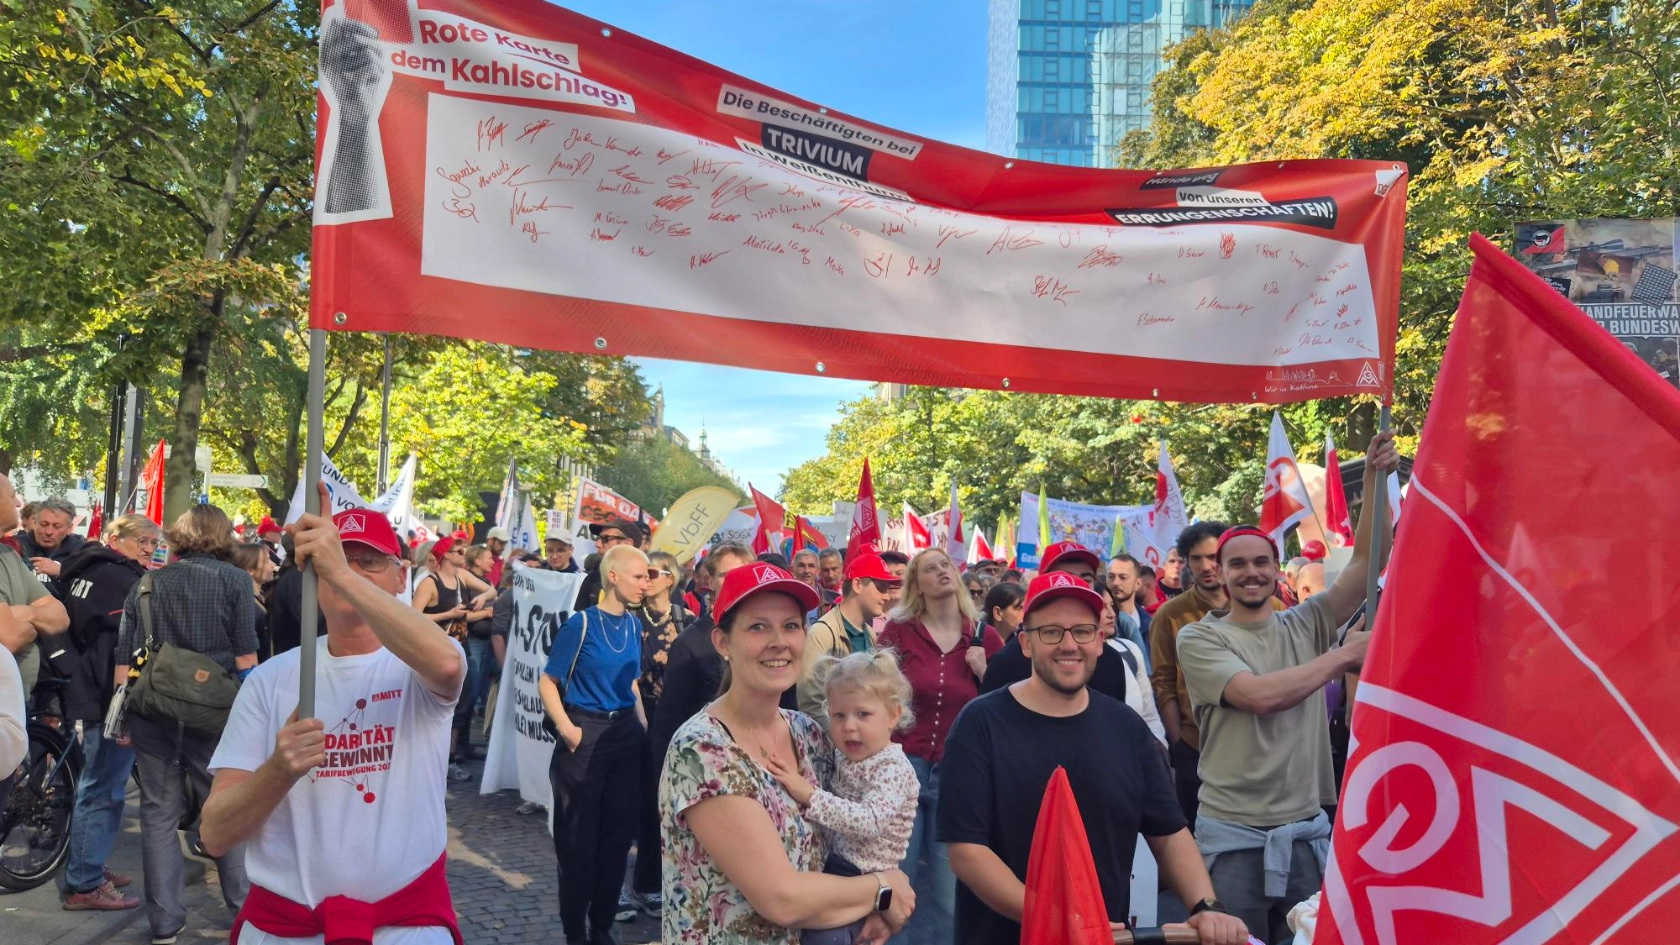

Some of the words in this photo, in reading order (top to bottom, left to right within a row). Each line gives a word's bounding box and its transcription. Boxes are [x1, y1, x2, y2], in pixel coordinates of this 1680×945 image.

[419, 20, 488, 44] Rote
[494, 33, 570, 66] Karte
[391, 51, 446, 74] dem
[452, 58, 627, 107] Kahlschlag!
[723, 91, 753, 110] Die
[757, 100, 884, 146] Beschäftigten
[888, 141, 917, 156] bei
[767, 128, 864, 176] TRIVIUM
[1115, 202, 1335, 226] ERRUNGENSCHAFTEN!
[1179, 191, 1204, 204] von
[1206, 193, 1263, 206] unseren
[673, 503, 711, 547] VbFF
